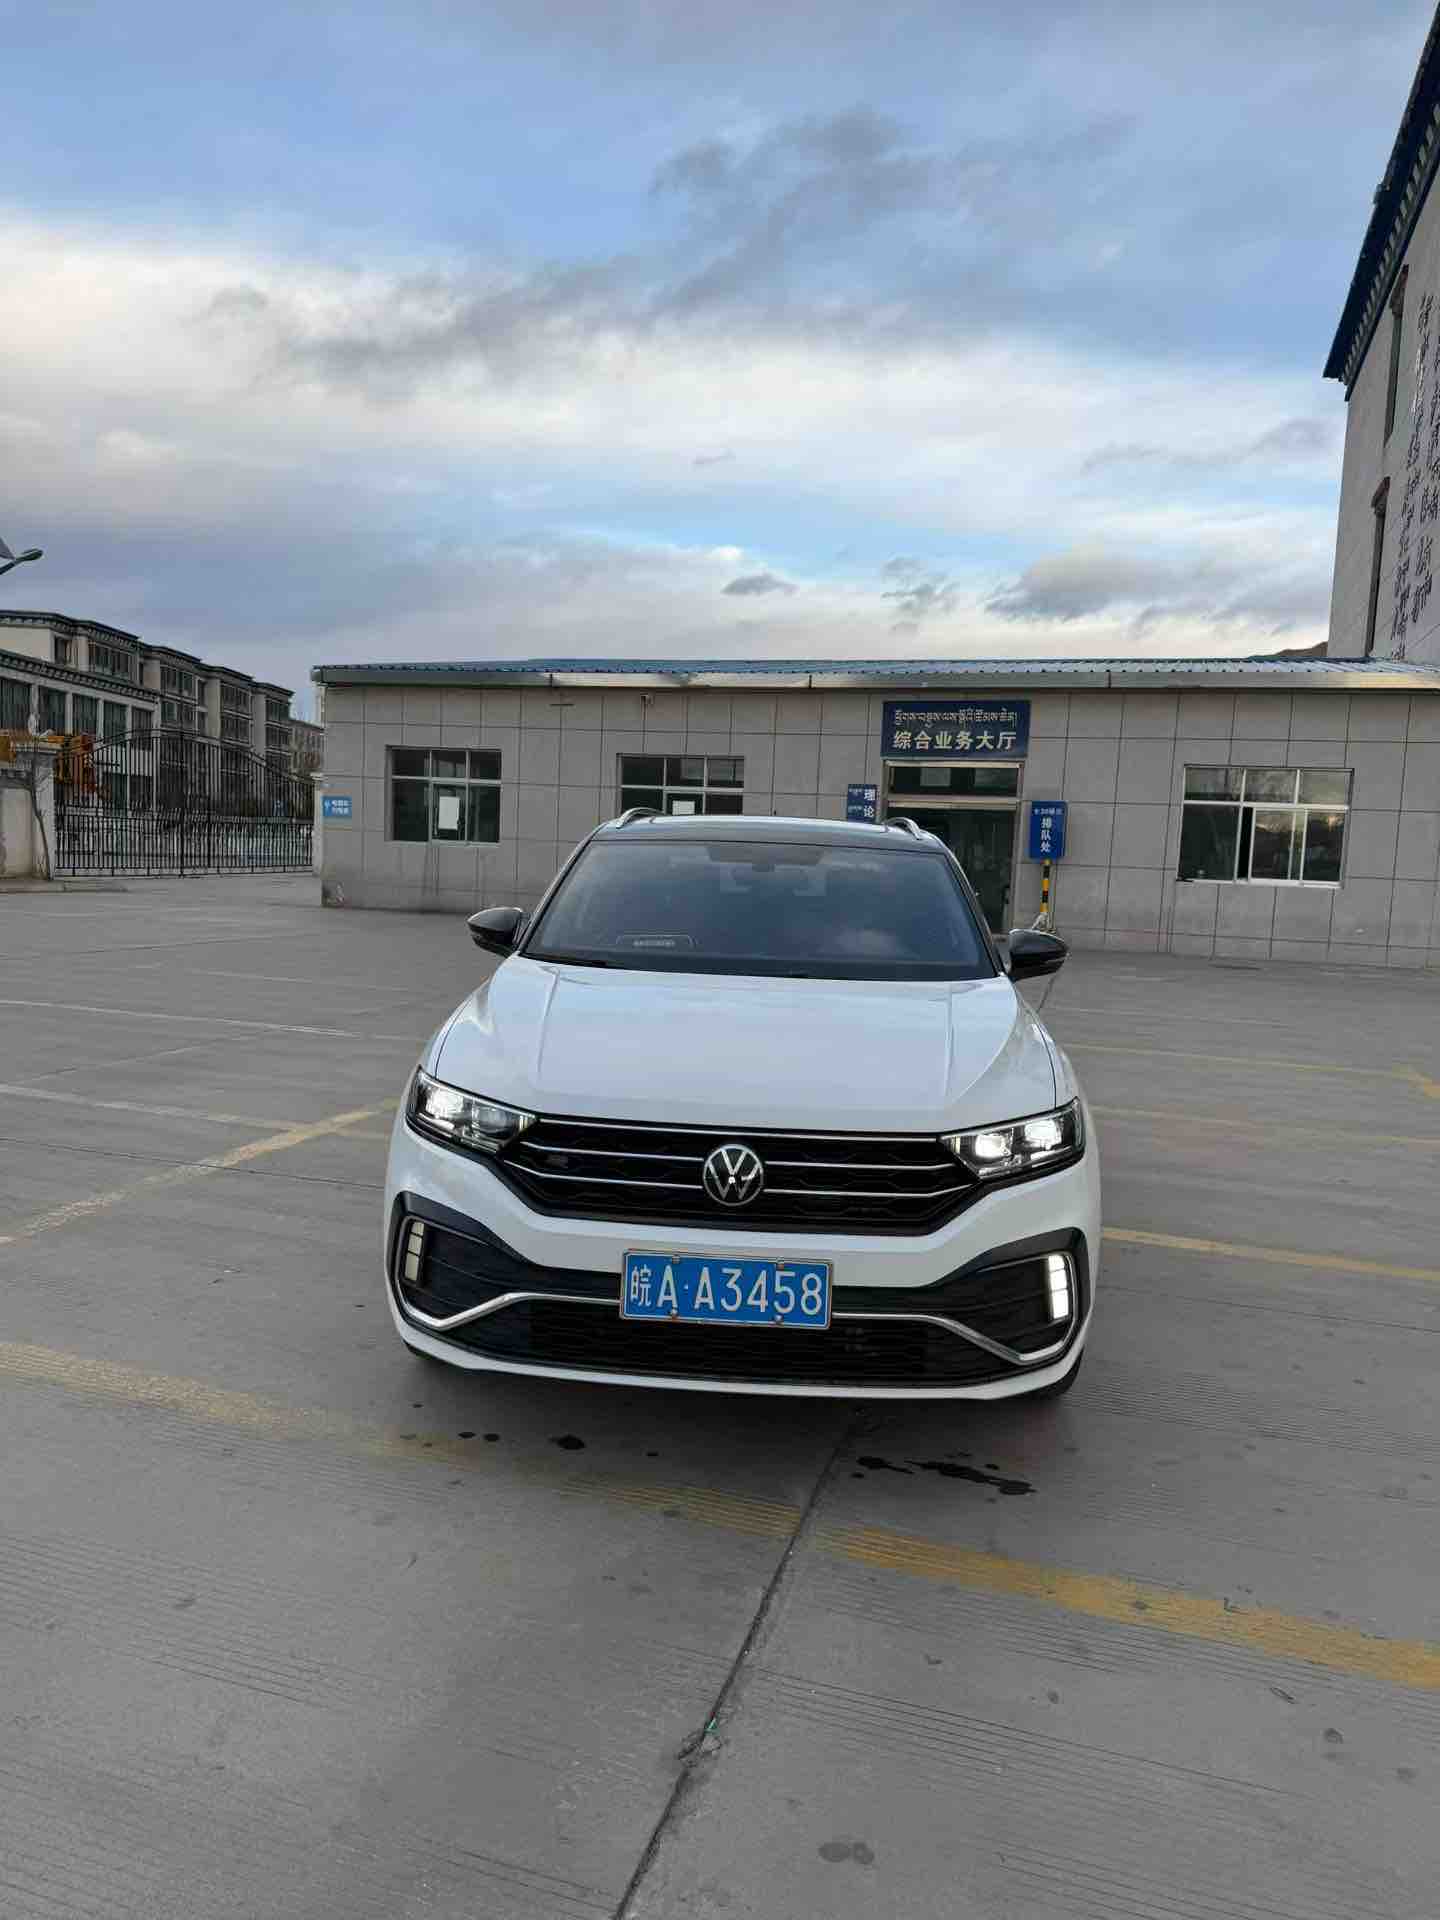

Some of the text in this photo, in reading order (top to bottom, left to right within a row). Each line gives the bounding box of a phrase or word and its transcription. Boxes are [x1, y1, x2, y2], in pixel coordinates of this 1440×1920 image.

[893, 730, 1017, 750] 综合业务大厅
[864, 788, 876, 818] 理论
[1040, 816, 1052, 853] 排队处
